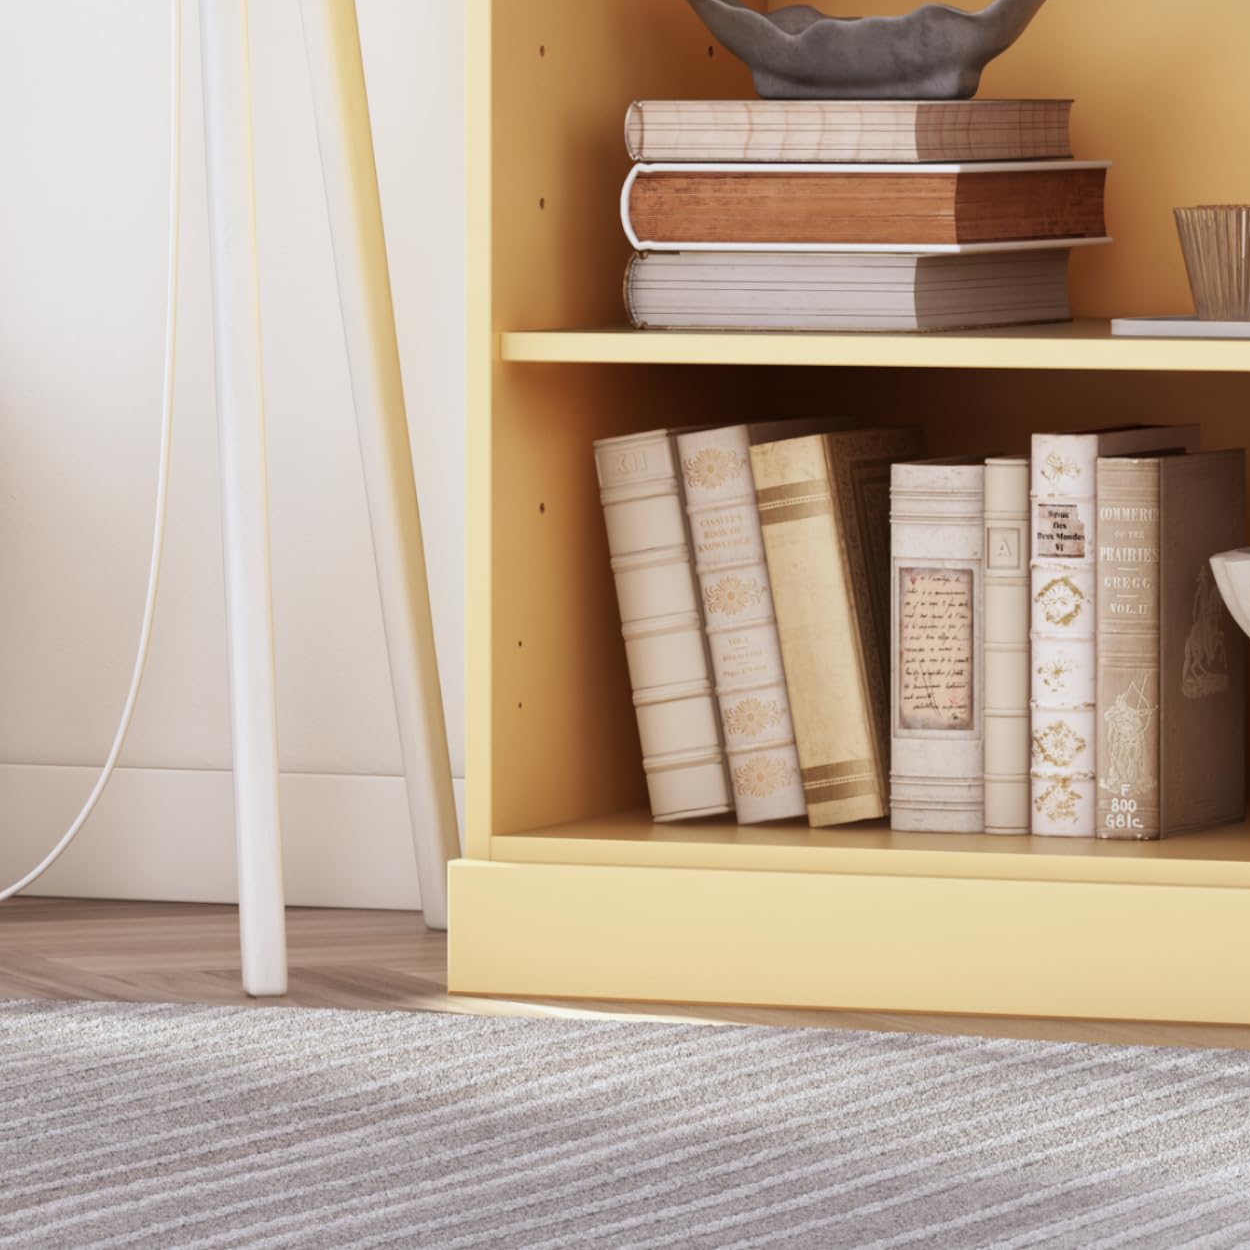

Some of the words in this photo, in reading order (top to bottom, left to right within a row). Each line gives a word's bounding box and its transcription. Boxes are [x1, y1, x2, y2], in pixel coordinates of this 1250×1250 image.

[996, 538, 1013, 558] A
[1099, 546, 1159, 562] PRAIRIES
[1121, 783, 1130, 797] F
[1111, 797, 1137, 813] 800
